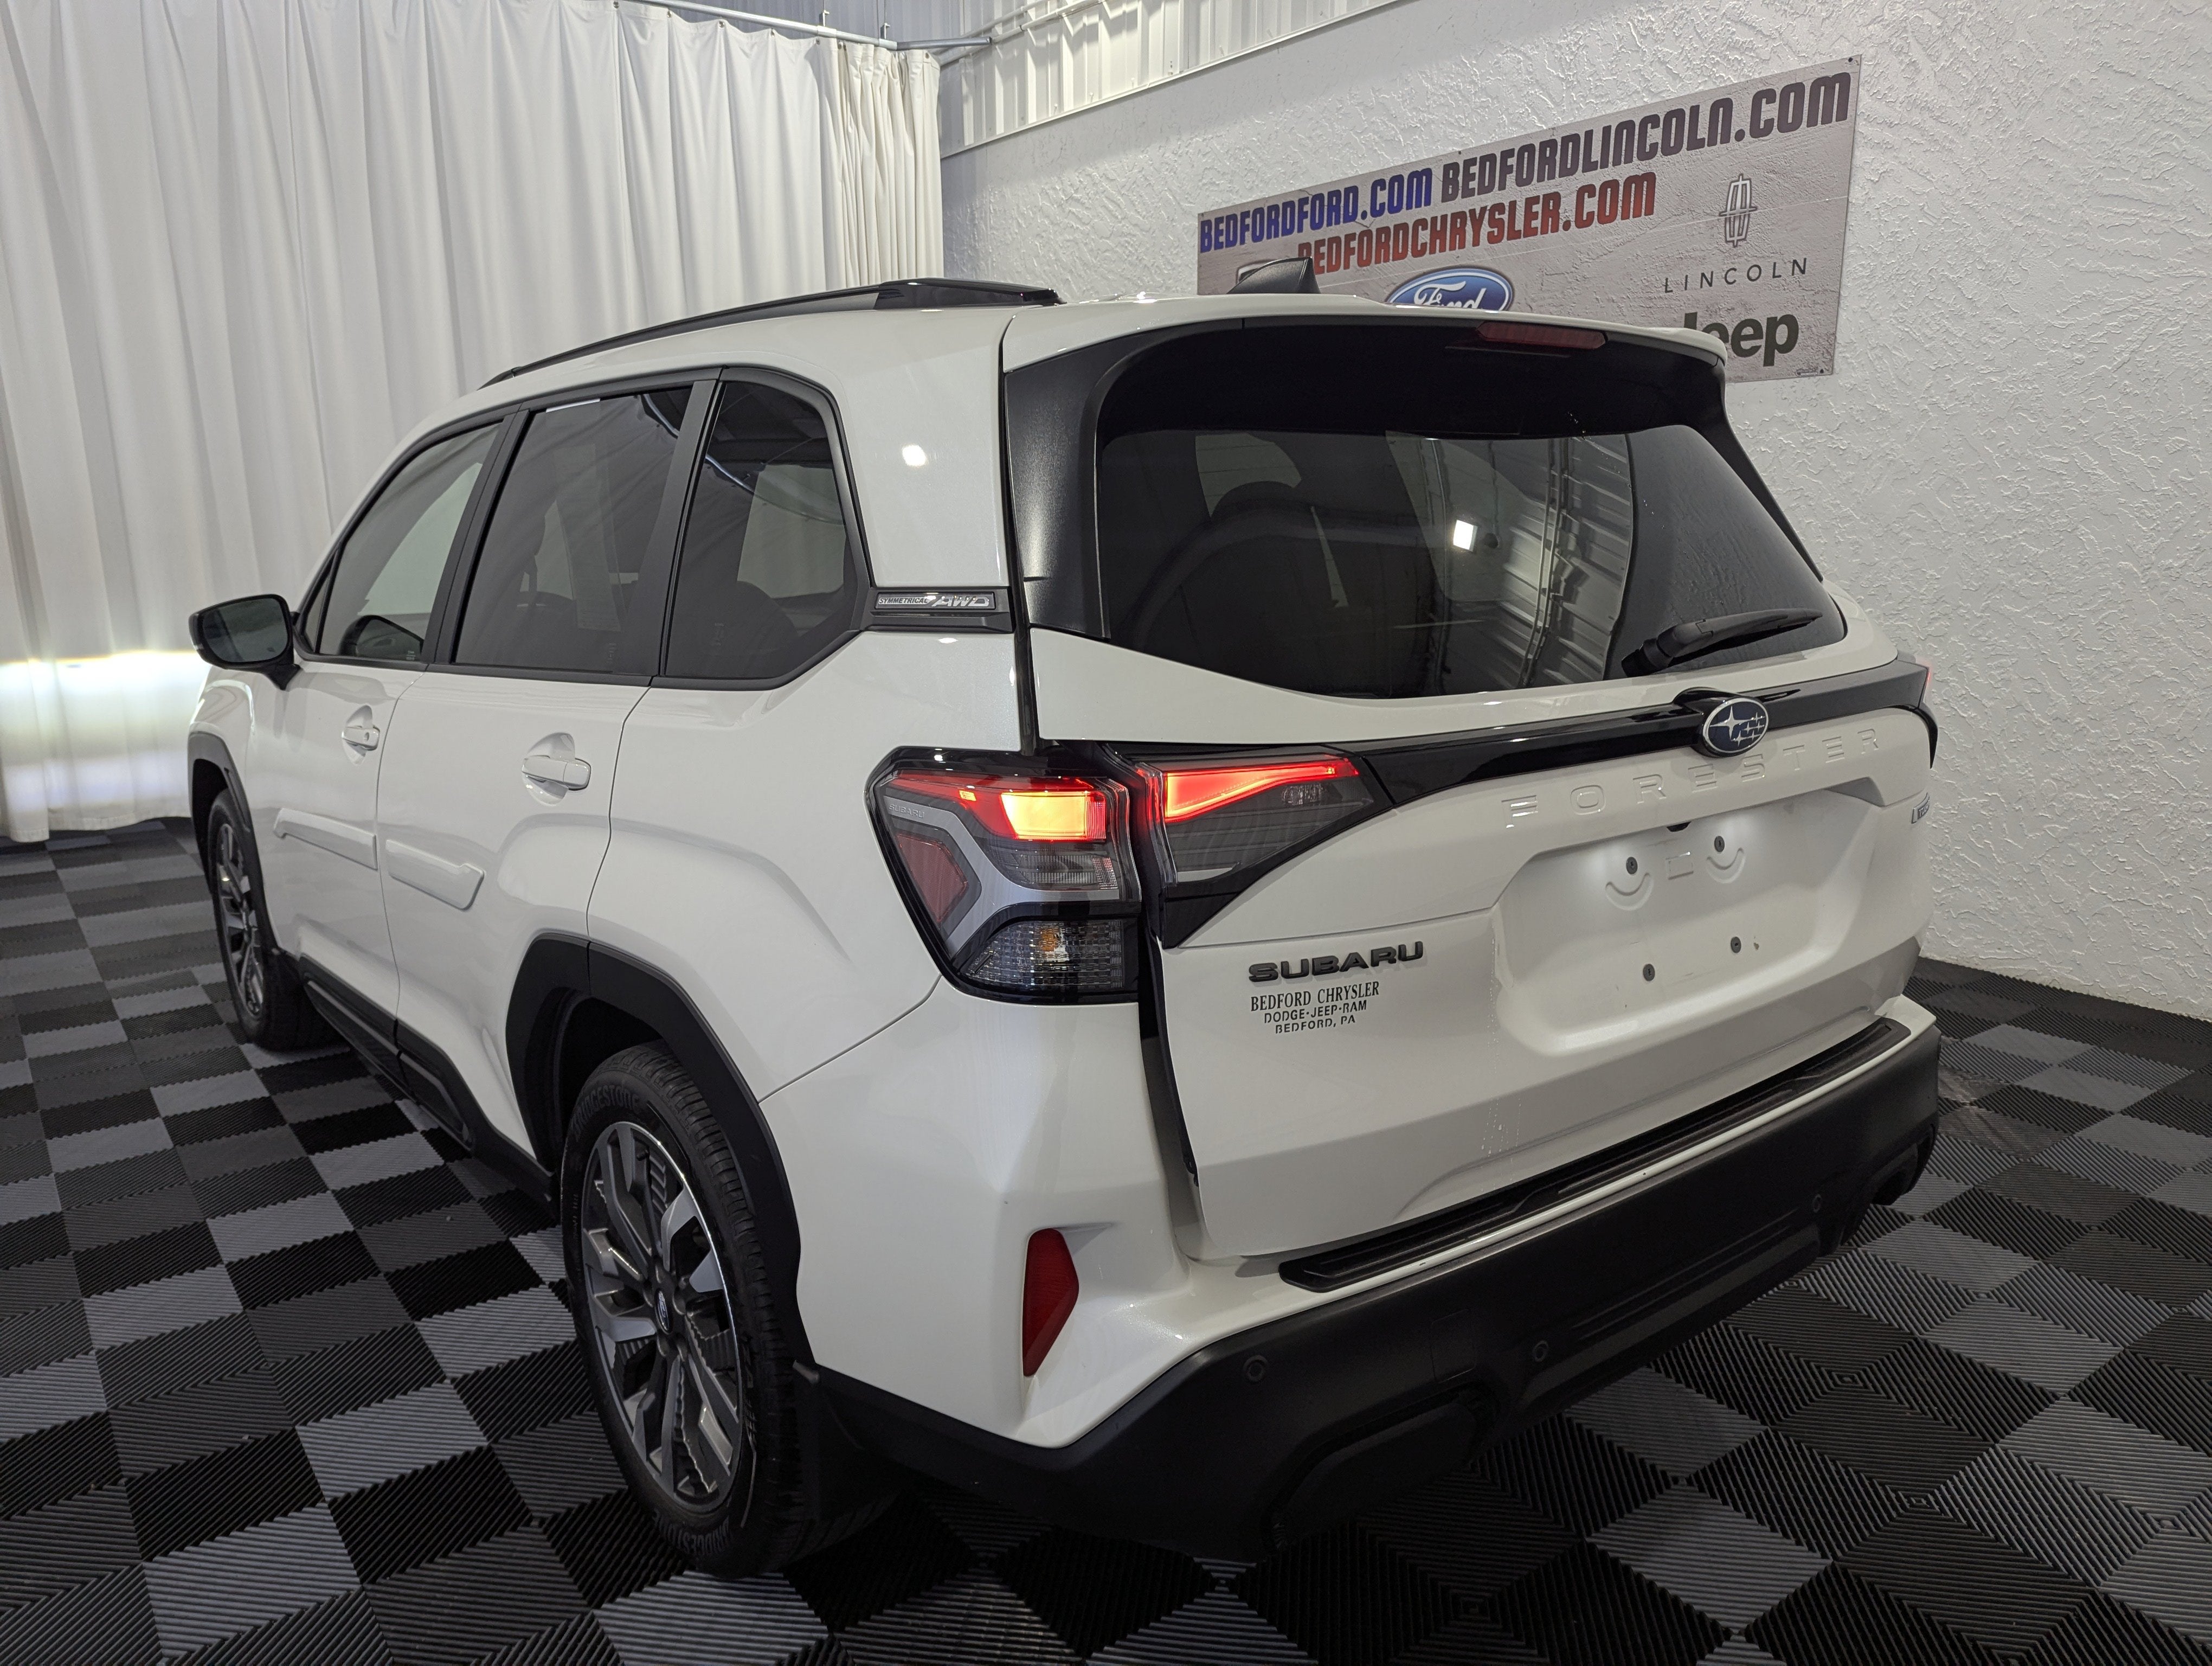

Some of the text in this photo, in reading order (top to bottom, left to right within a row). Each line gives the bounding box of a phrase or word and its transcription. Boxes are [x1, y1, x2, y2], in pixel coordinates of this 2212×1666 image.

[1200, 72, 1851, 253] BEDFORDFORD.COM BEDFORDLINCOLN.COM
[1664, 258, 1806, 293] LINCOLN
[1414, 280, 1487, 309] Fd
[1683, 311, 1799, 367] ep
[878, 595, 989, 607] SYMMETRICAL AWD
[1501, 727, 1881, 829] FORESTER
[889, 803, 925, 819] SUBARU
[1249, 941, 1424, 983] SUBARU
[1251, 981, 1380, 1011] BEDFORD CHRYSLER
[1276, 1014, 1356, 1034] BEDFORD, PA
